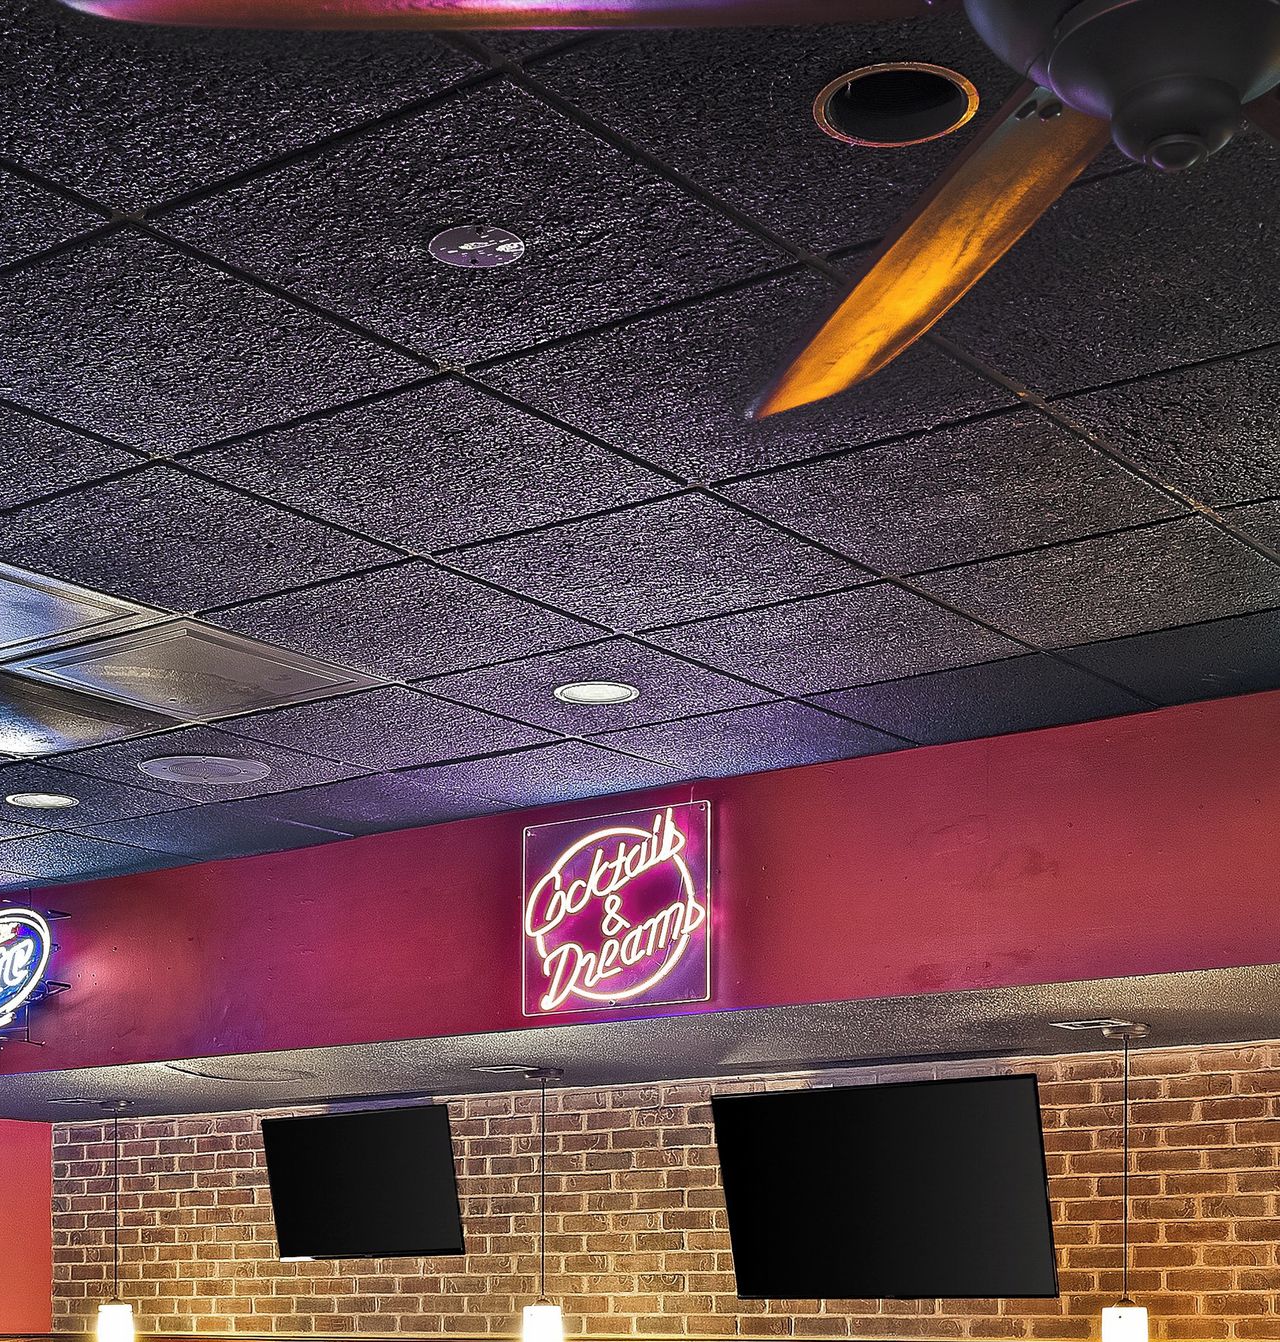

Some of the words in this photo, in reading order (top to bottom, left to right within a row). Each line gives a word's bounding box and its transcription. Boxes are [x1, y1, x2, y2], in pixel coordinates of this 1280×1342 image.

[525, 807, 686, 937] Cocktails
[601, 894, 631, 937] &
[541, 895, 706, 1011] Dreams
